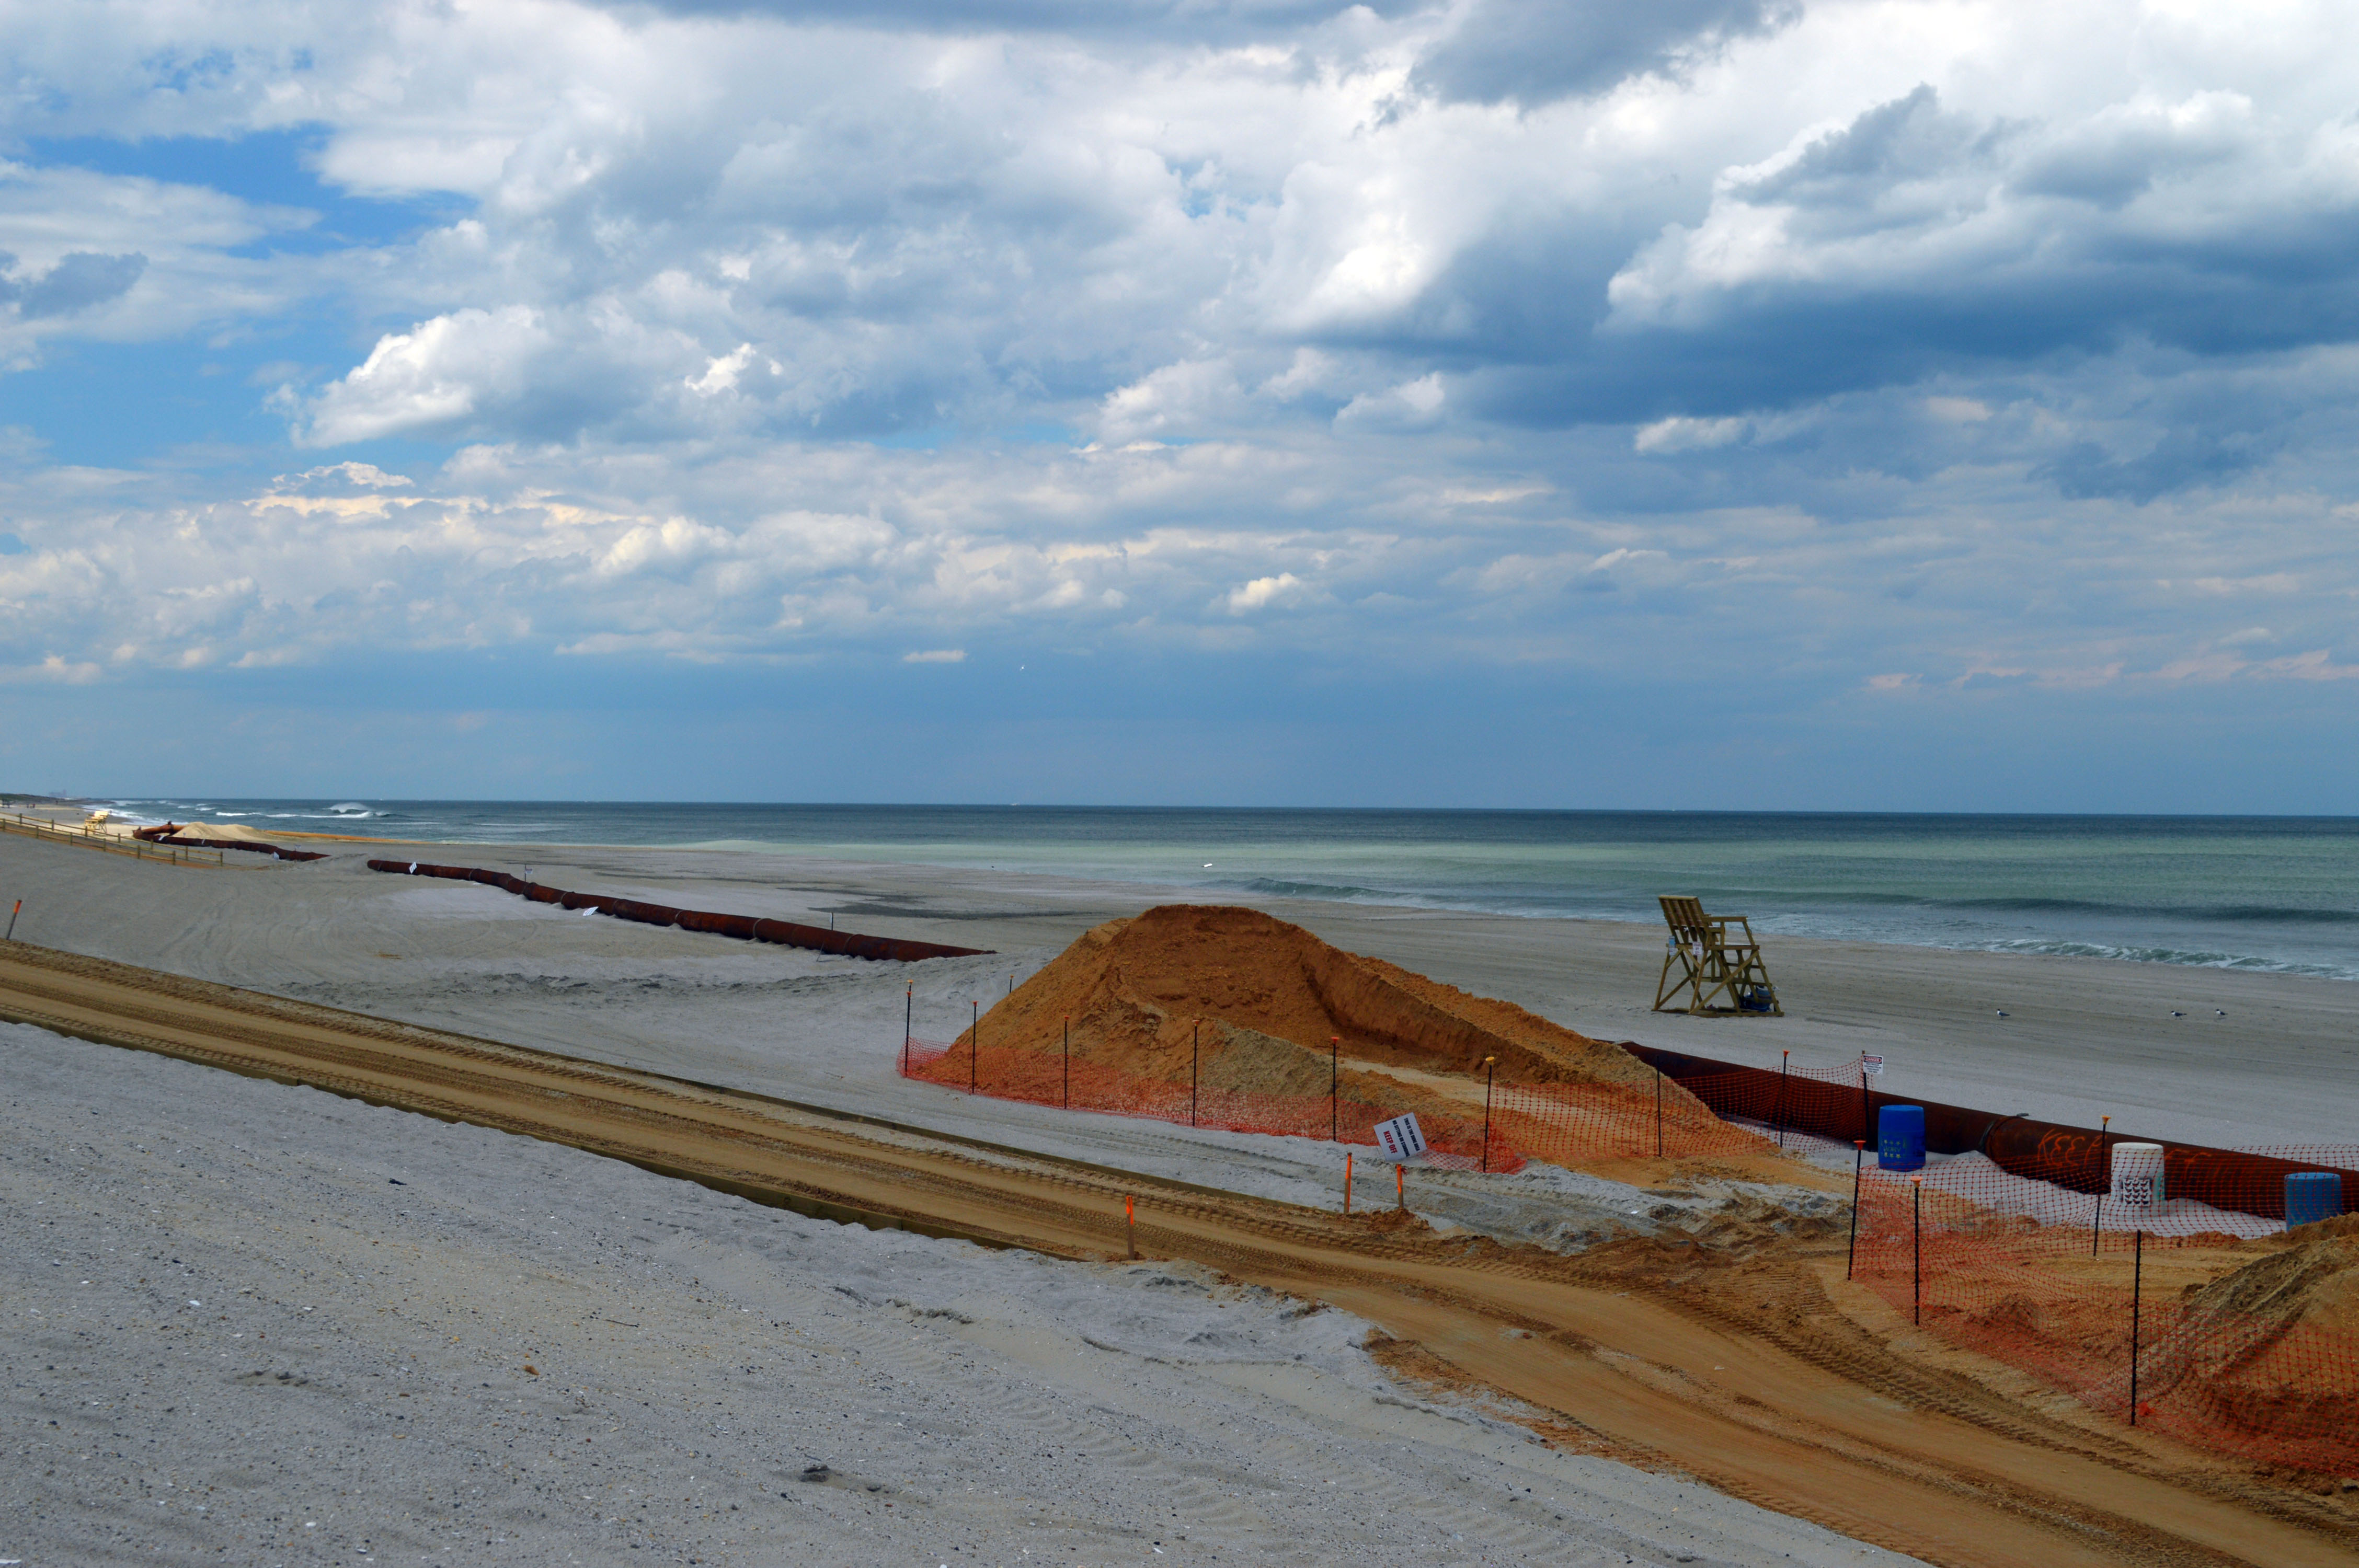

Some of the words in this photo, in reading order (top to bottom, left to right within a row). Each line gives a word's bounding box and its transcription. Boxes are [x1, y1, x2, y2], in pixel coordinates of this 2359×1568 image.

[1383, 1131, 1393, 1144] KEEP
[1389, 1144, 1398, 1153] OFF
[1401, 1142, 1410, 1157] STANDING
[2037, 1128, 2107, 1168] KEEP
